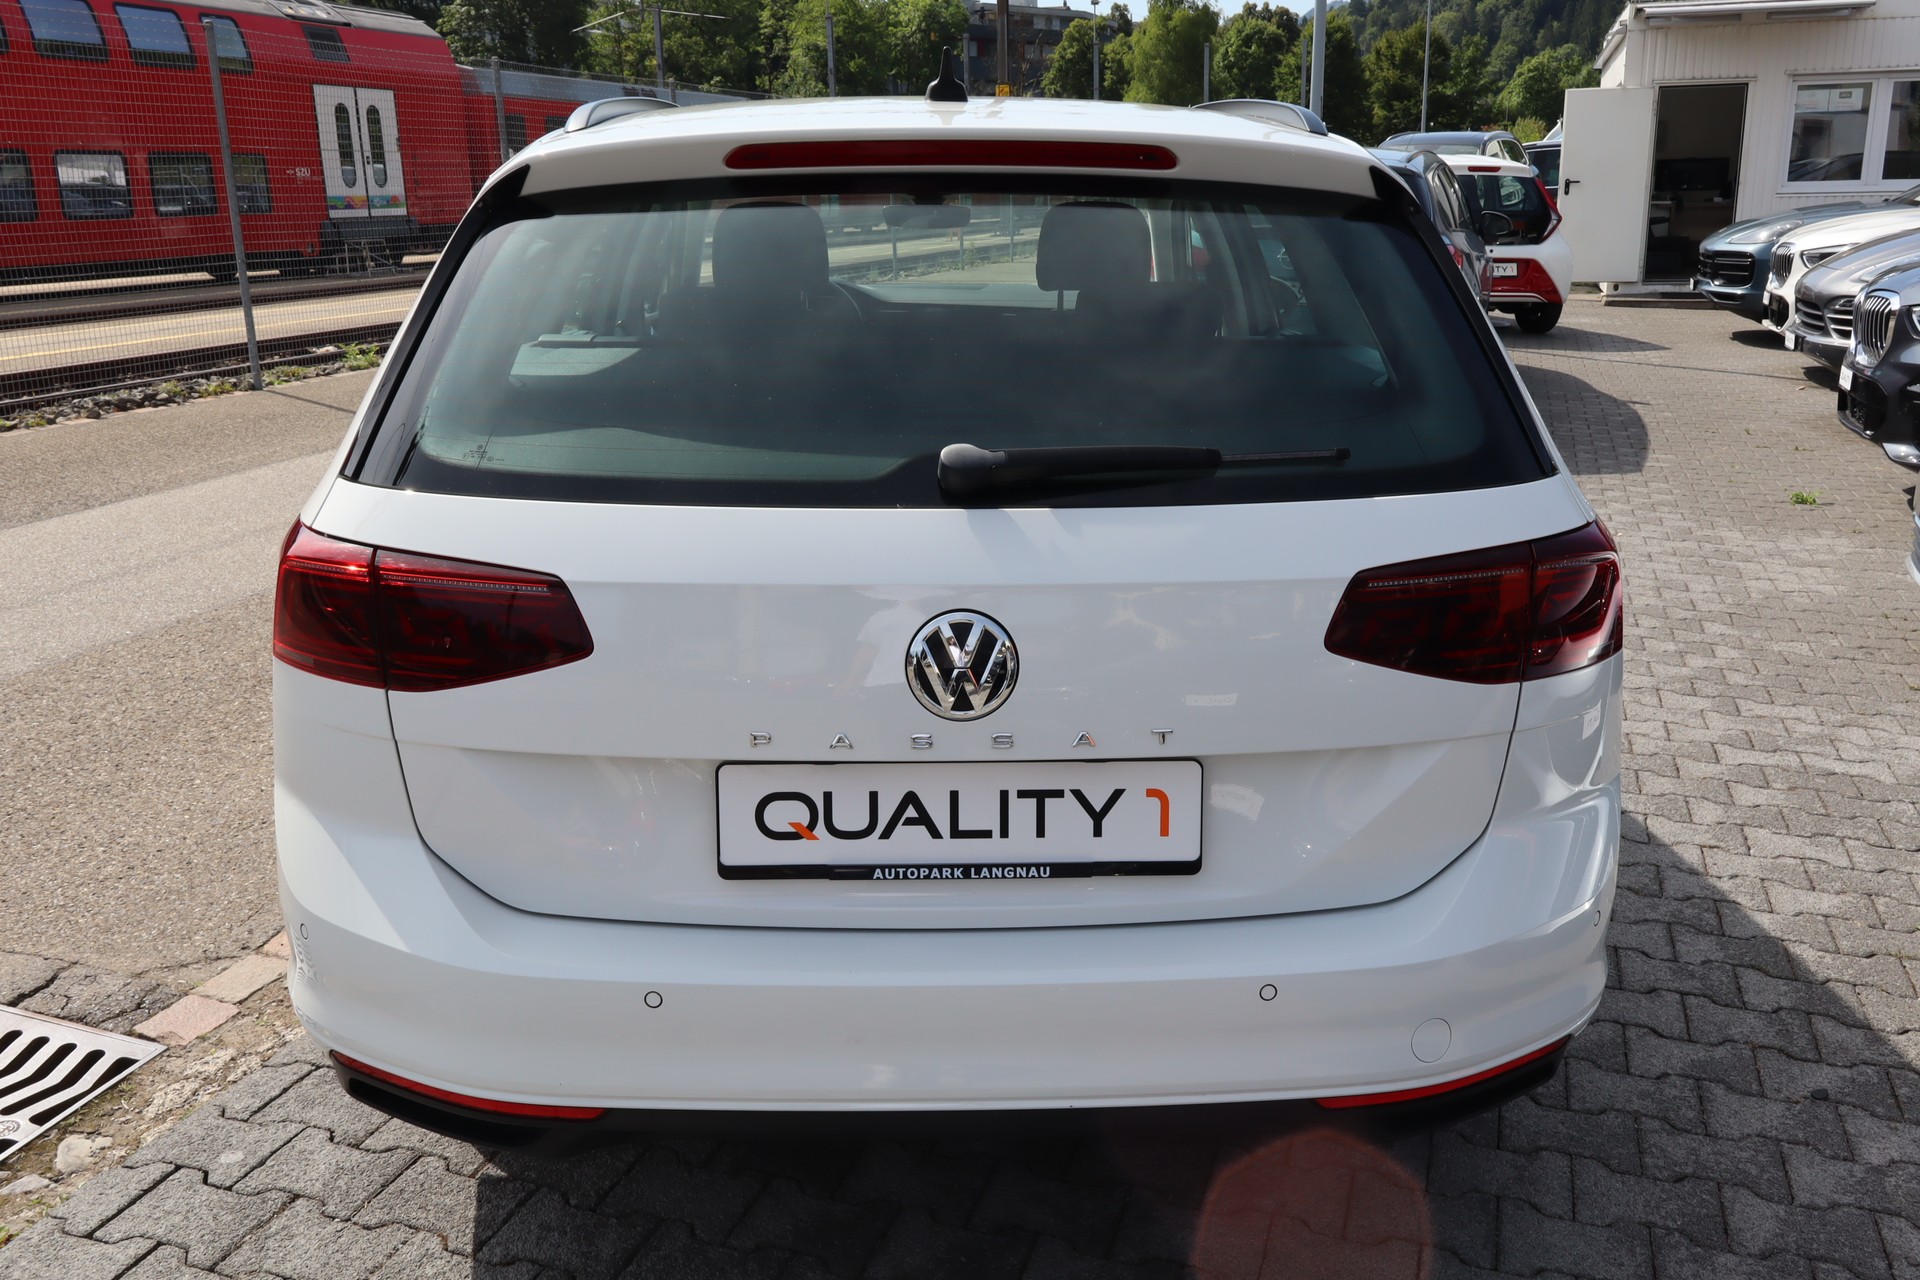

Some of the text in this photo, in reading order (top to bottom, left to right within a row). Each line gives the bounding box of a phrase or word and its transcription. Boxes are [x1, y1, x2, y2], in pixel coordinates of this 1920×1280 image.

[911, 614, 1013, 716] VW
[750, 728, 1174, 750] PASSAT
[754, 788, 1170, 841] QUALITY 1
[873, 866, 1051, 880] AUTOPARK LANGNAU
